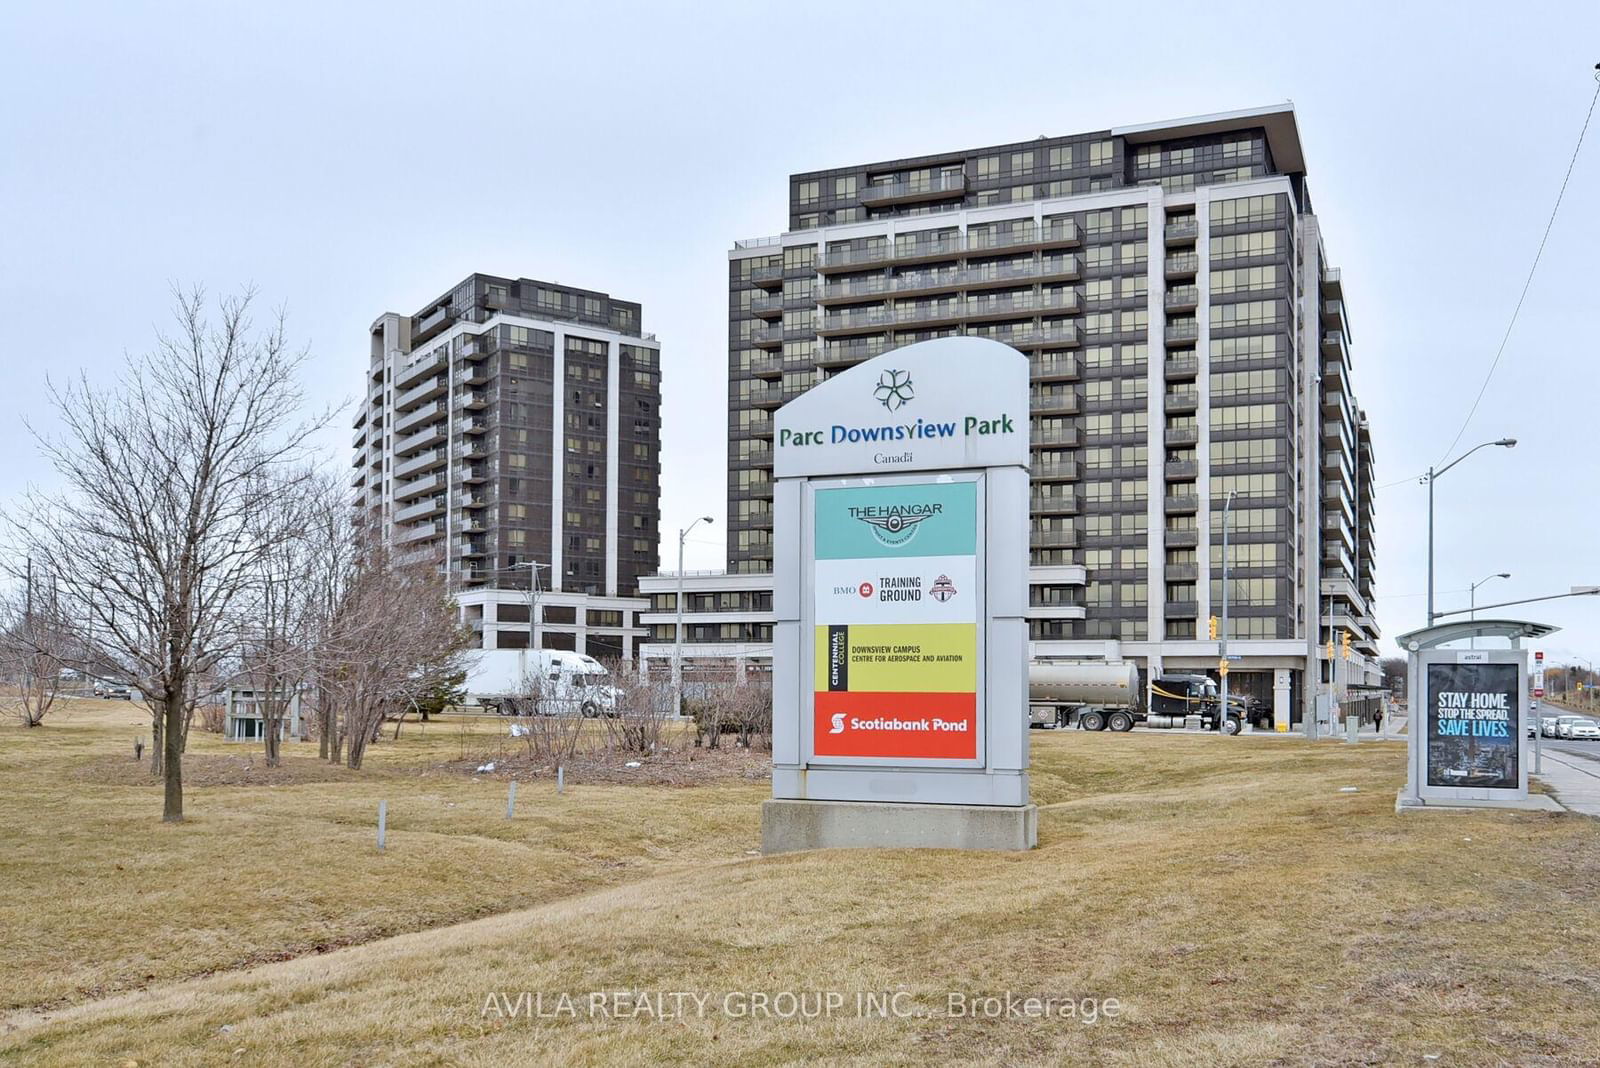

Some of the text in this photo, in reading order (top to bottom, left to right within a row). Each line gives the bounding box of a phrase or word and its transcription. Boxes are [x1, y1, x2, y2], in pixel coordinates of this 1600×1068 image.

[779, 413, 1015, 447] Parc Downsview Park
[873, 451, 913, 464] Canada
[848, 503, 942, 518] THE HANGAR
[879, 576, 921, 589] TRAINING
[833, 587, 856, 595] BMO
[879, 589, 921, 602] GROUND
[851, 645, 921, 654] DOWNSVIEW CAMPUS
[875, 655, 886, 663] FOR
[888, 655, 920, 663] AEROSPACE
[922, 655, 935, 663] AND
[936, 655, 963, 663] AVIATION
[1438, 692, 1510, 709] STAY HOME.
[1438, 708, 1510, 721] STOP THE SPREAD.
[851, 718, 968, 732] Scotiabank Pond
[1438, 720, 1510, 738] SAVE LIVES.
